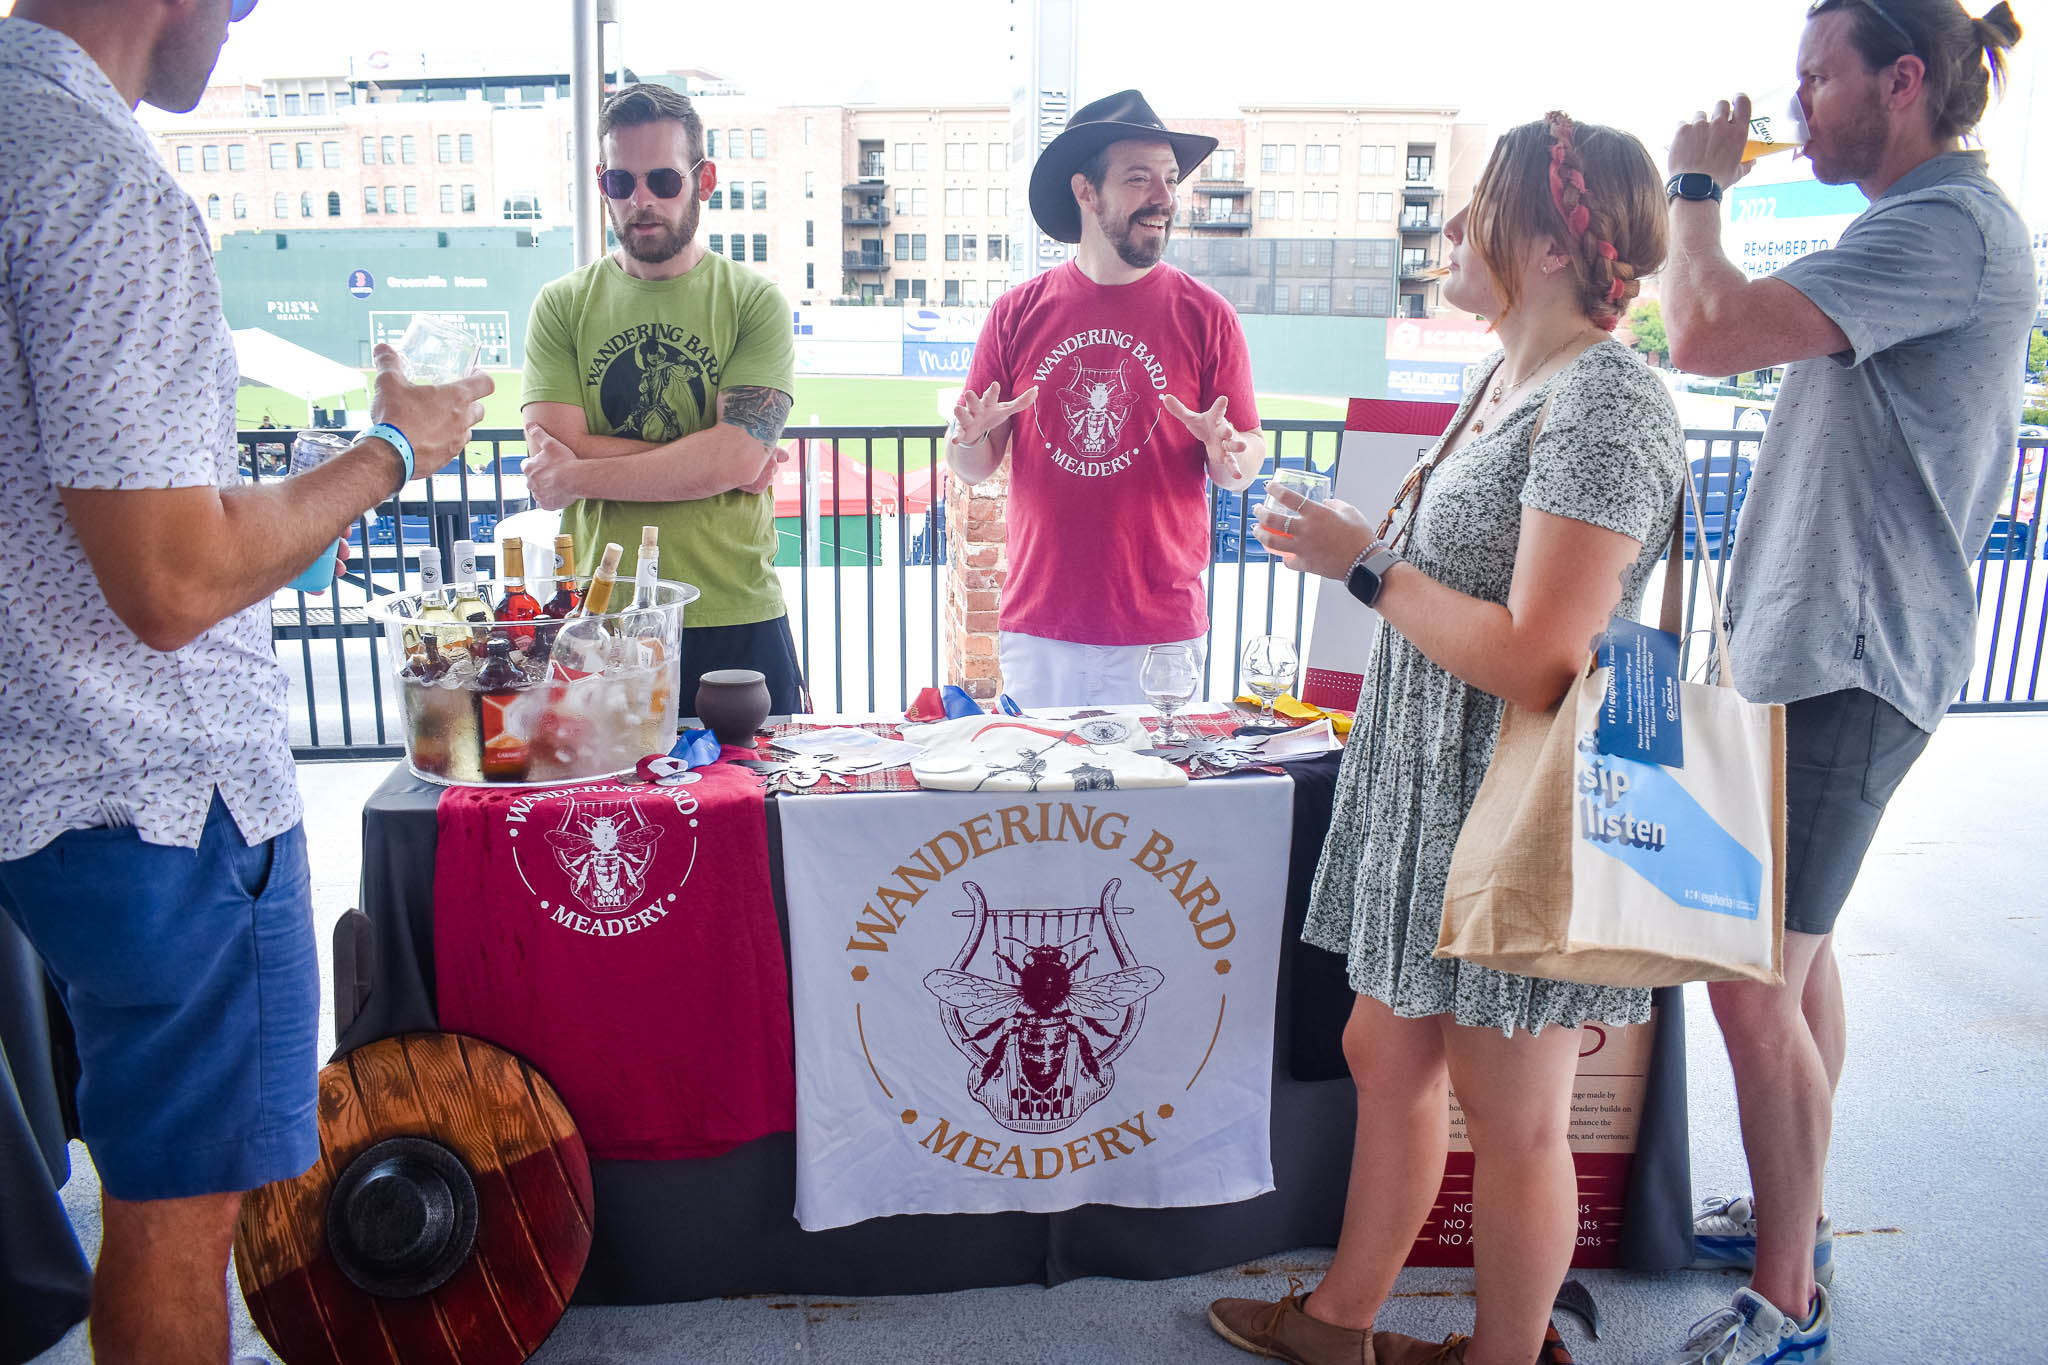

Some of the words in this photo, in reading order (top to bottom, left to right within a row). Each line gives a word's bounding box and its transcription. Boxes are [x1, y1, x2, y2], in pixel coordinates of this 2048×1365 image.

[1738, 197, 1777, 221] 2022
[1743, 240, 1807, 257] REMEMBER
[267, 301, 319, 313] PRISMA
[586, 323, 684, 387] WANDERING
[684, 334, 720, 386] BARD
[918, 347, 974, 375] Mill
[1033, 328, 1134, 382] WANDERING
[1131, 342, 1168, 390] BARD
[1051, 448, 1133, 477] MEADERY
[1608, 666, 1618, 705] euphoria
[1581, 757, 1631, 804] sip
[506, 785, 647, 823] WANDERING
[648, 786, 699, 815] BARD
[1582, 797, 1667, 847] listen
[846, 802, 1130, 953] WANDERING
[1130, 829, 1236, 950] BARD
[550, 898, 670, 937] MEADERY
[1586, 1091, 1606, 1099] made
[1600, 1105, 1621, 1113] builds
[918, 1111, 1157, 1180] MEADERY
[1580, 1132, 1594, 1140] and
[1453, 1203, 1473, 1213] NO
[1444, 1219, 1465, 1229] NO
[1438, 1234, 1462, 1245] NO
